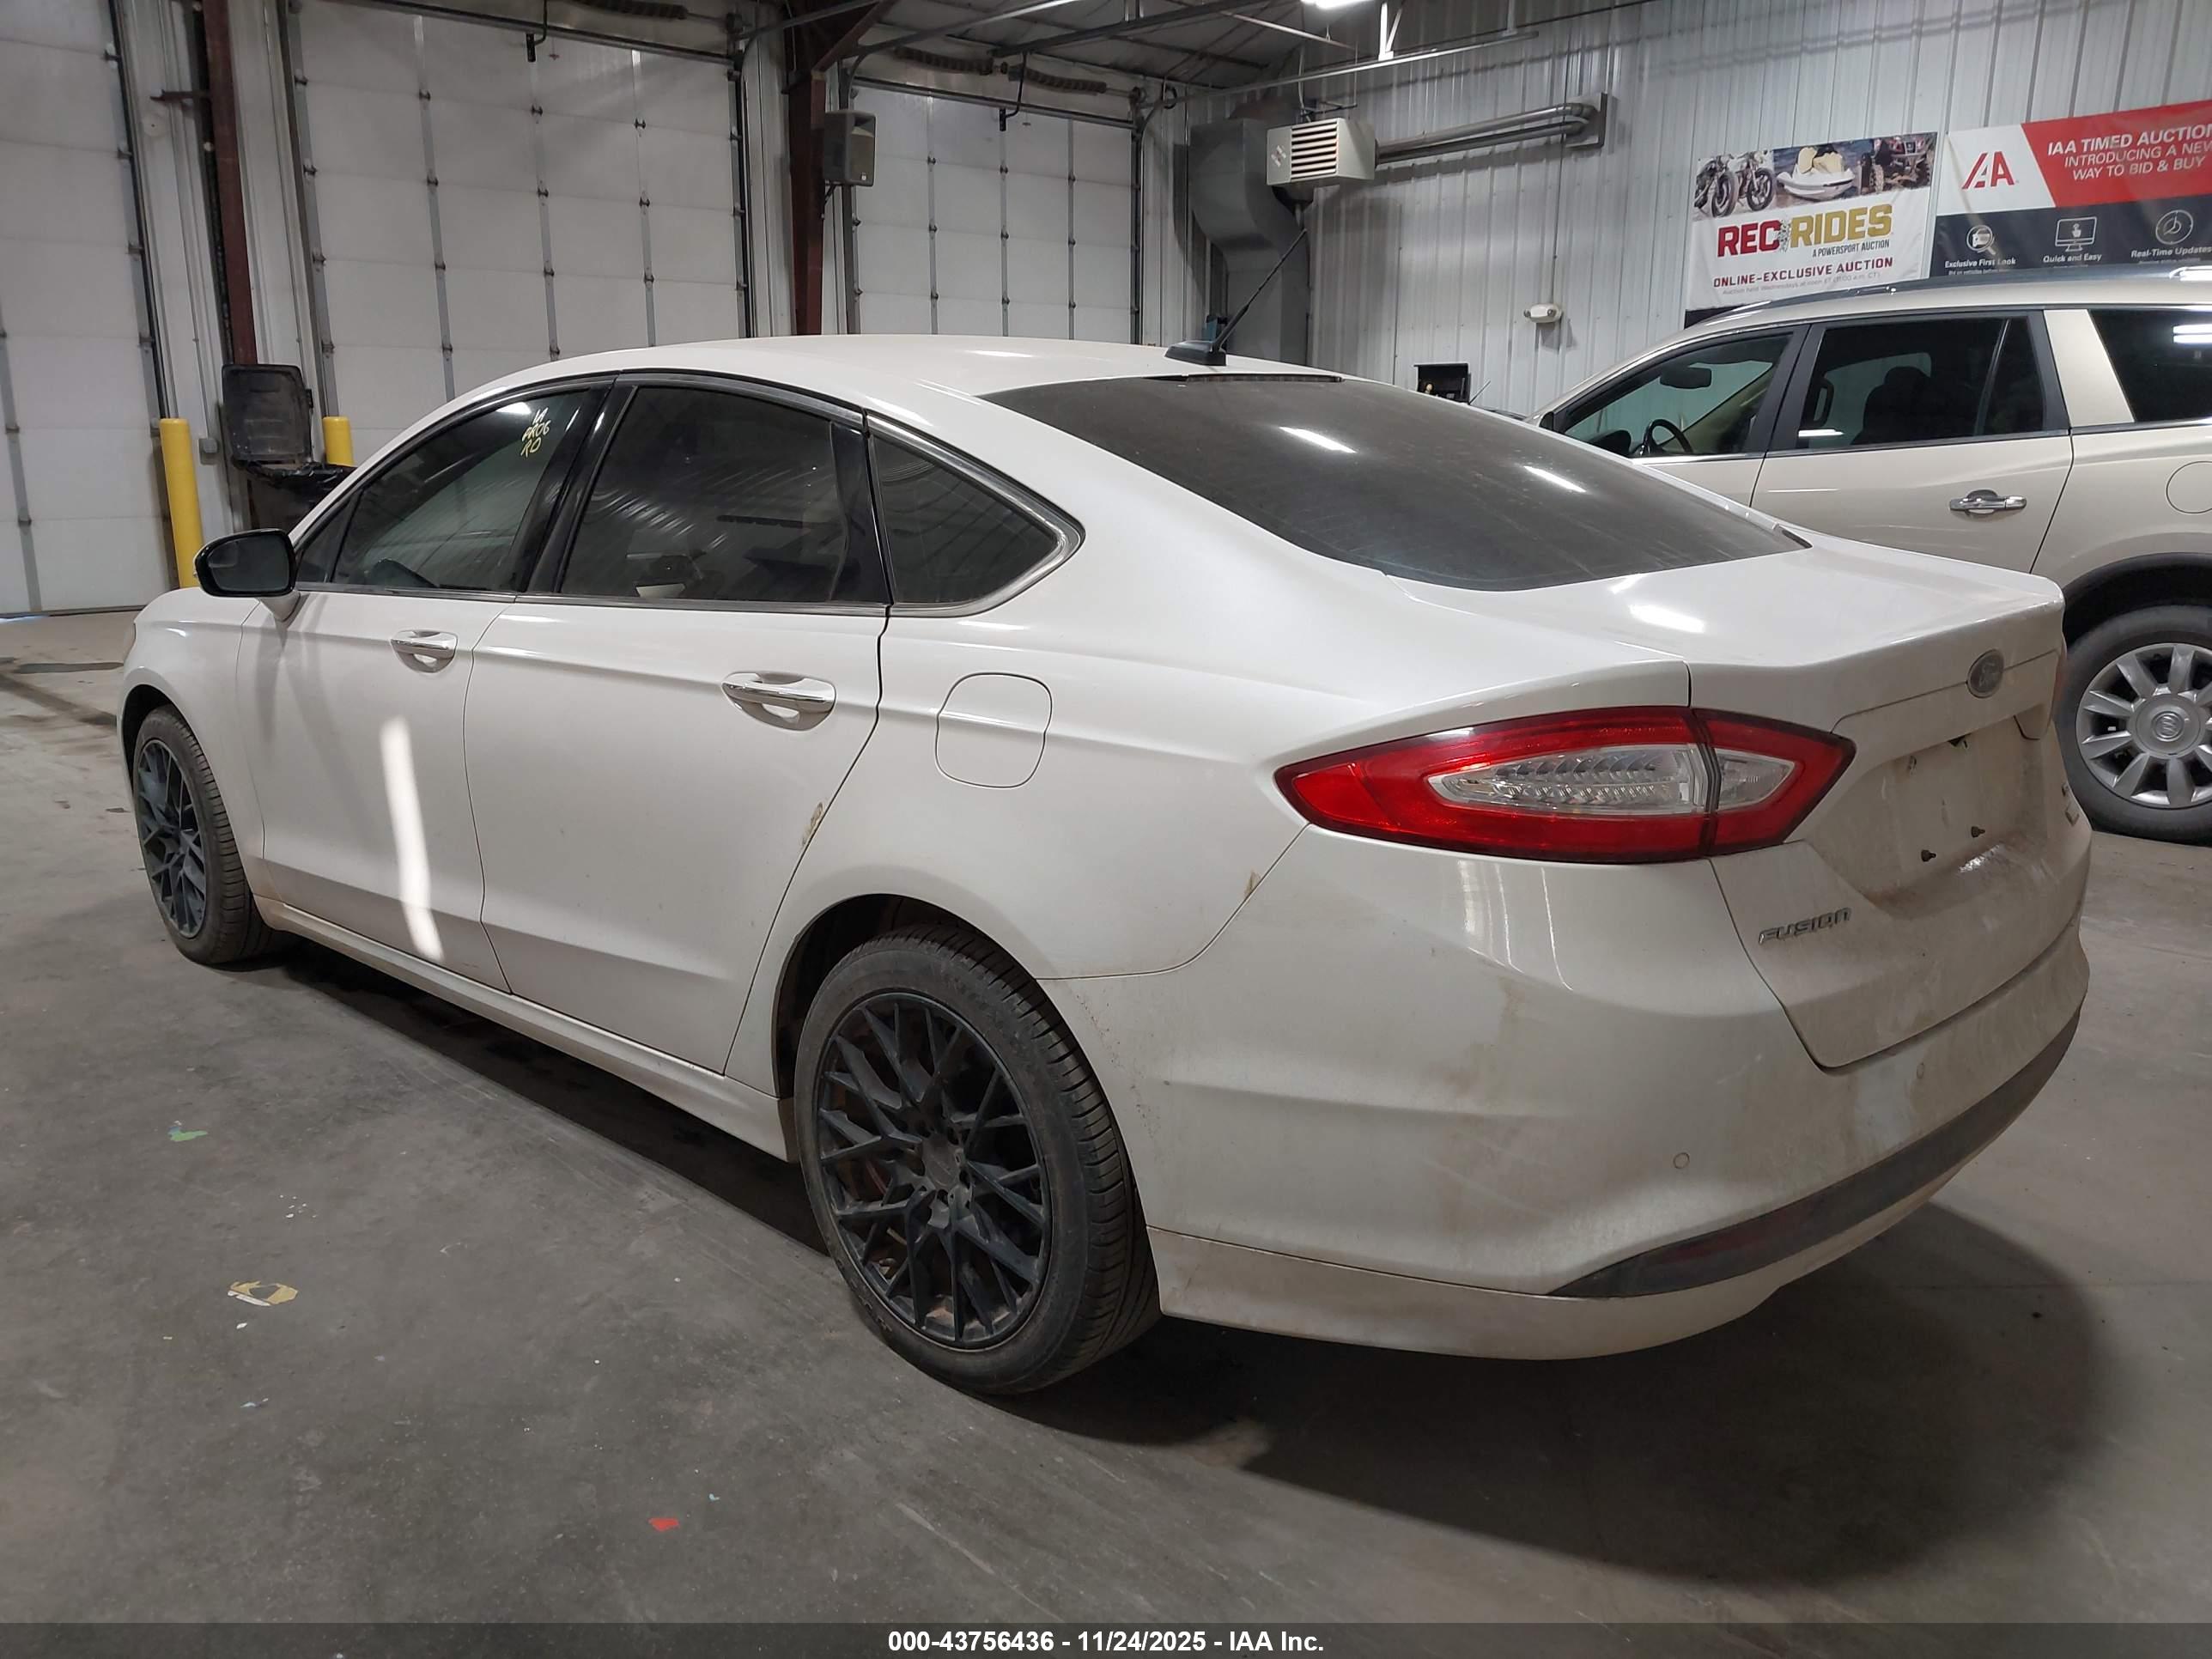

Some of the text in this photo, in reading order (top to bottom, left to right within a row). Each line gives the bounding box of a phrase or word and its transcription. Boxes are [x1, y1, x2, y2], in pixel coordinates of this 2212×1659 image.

[2047, 141, 2077, 156] IAA
[2081, 134, 2134, 153] TIMED
[2064, 146, 2161, 167] INTRODUCING
[2166, 144, 2178, 157] A
[2073, 155, 2206, 181] WAY TO BID & BUY
[1717, 204, 1893, 258] REC RIDES
[1818, 244, 1859, 257] POWERSPORT
[1861, 240, 1890, 251] AUCTION
[2043, 252, 2102, 263] Quick and Easy
[2130, 247, 2173, 258] Real-Time
[1713, 257, 1893, 288] ONLINE-EXCLUSIVE AUCTION
[1945, 259, 1978, 269] Exclusive
